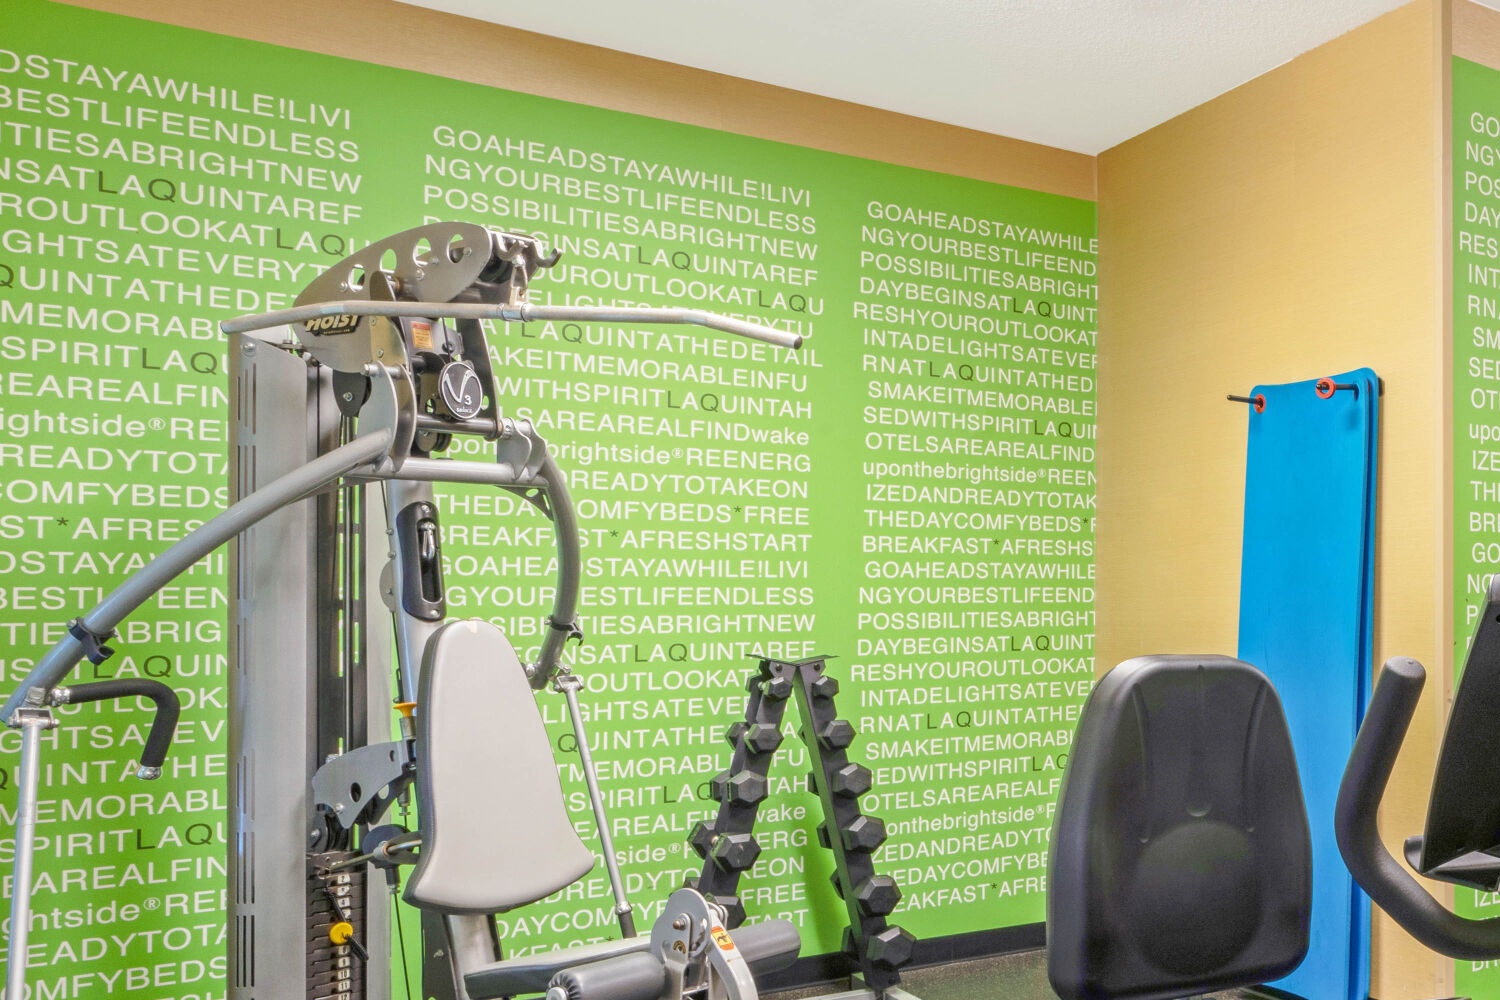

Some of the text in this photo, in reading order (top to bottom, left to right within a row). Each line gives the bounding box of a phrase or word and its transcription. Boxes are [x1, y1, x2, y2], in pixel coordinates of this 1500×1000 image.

[434, 126, 809, 206] GOAHEADSTAYAWHILE!LIVI
[426, 154, 816, 234] NGYOURBESTLIFEENDLESS
[424, 185, 817, 260] POSSIBILITIESABRIGHTNEW
[0, 372, 228, 408] EAREALFIN
[0, 408, 228, 442] ightside®RE
[0, 479, 229, 511] OMFYBEDS
[557, 468, 808, 498] READYTOTAKEON
[862, 680, 1095, 707] INTADELIGHTSATEVE
